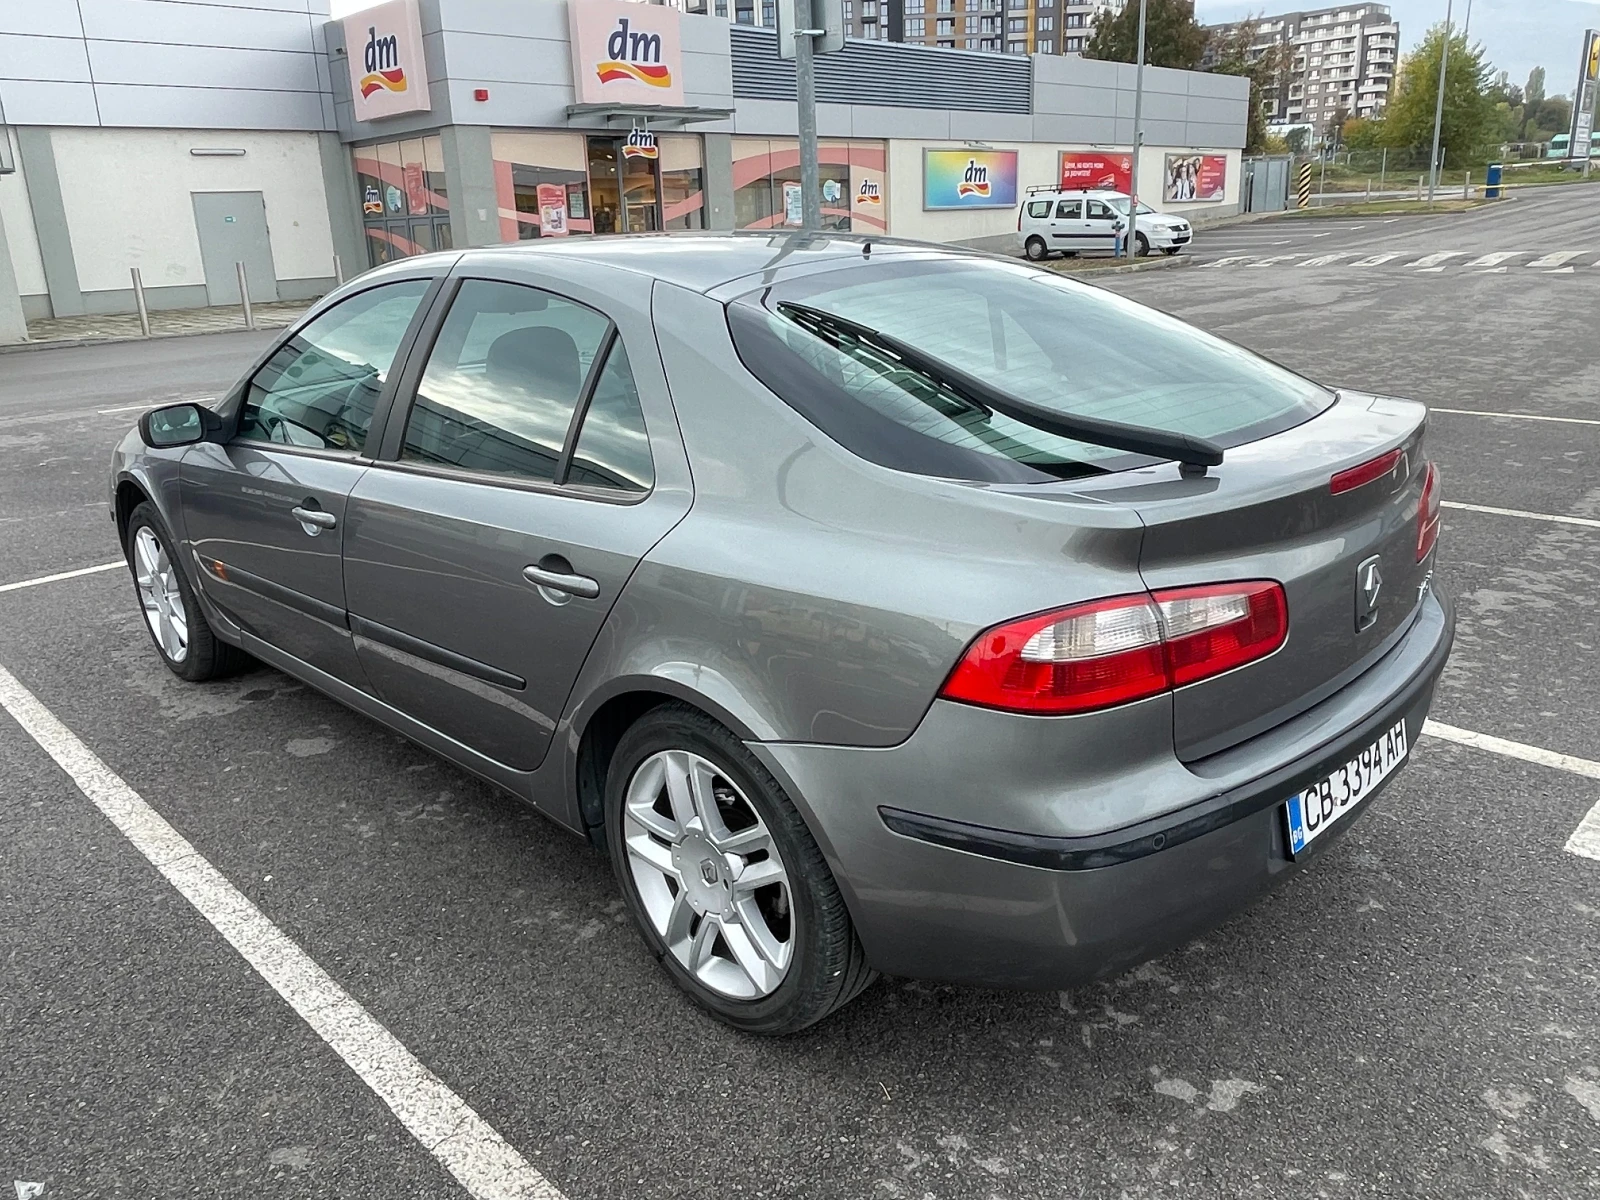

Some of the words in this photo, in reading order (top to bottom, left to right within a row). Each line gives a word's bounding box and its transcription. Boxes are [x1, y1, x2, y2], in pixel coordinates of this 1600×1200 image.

[364, 26, 398, 73] dm
[607, 18, 661, 63] dm
[630, 128, 653, 147] dm
[964, 160, 987, 183] dm
[860, 179, 878, 195] dm
[1304, 778, 1334, 831] CB
[1338, 740, 1383, 807] 3394
[1386, 720, 1405, 767] AH
[1293, 826, 1303, 844] BG
